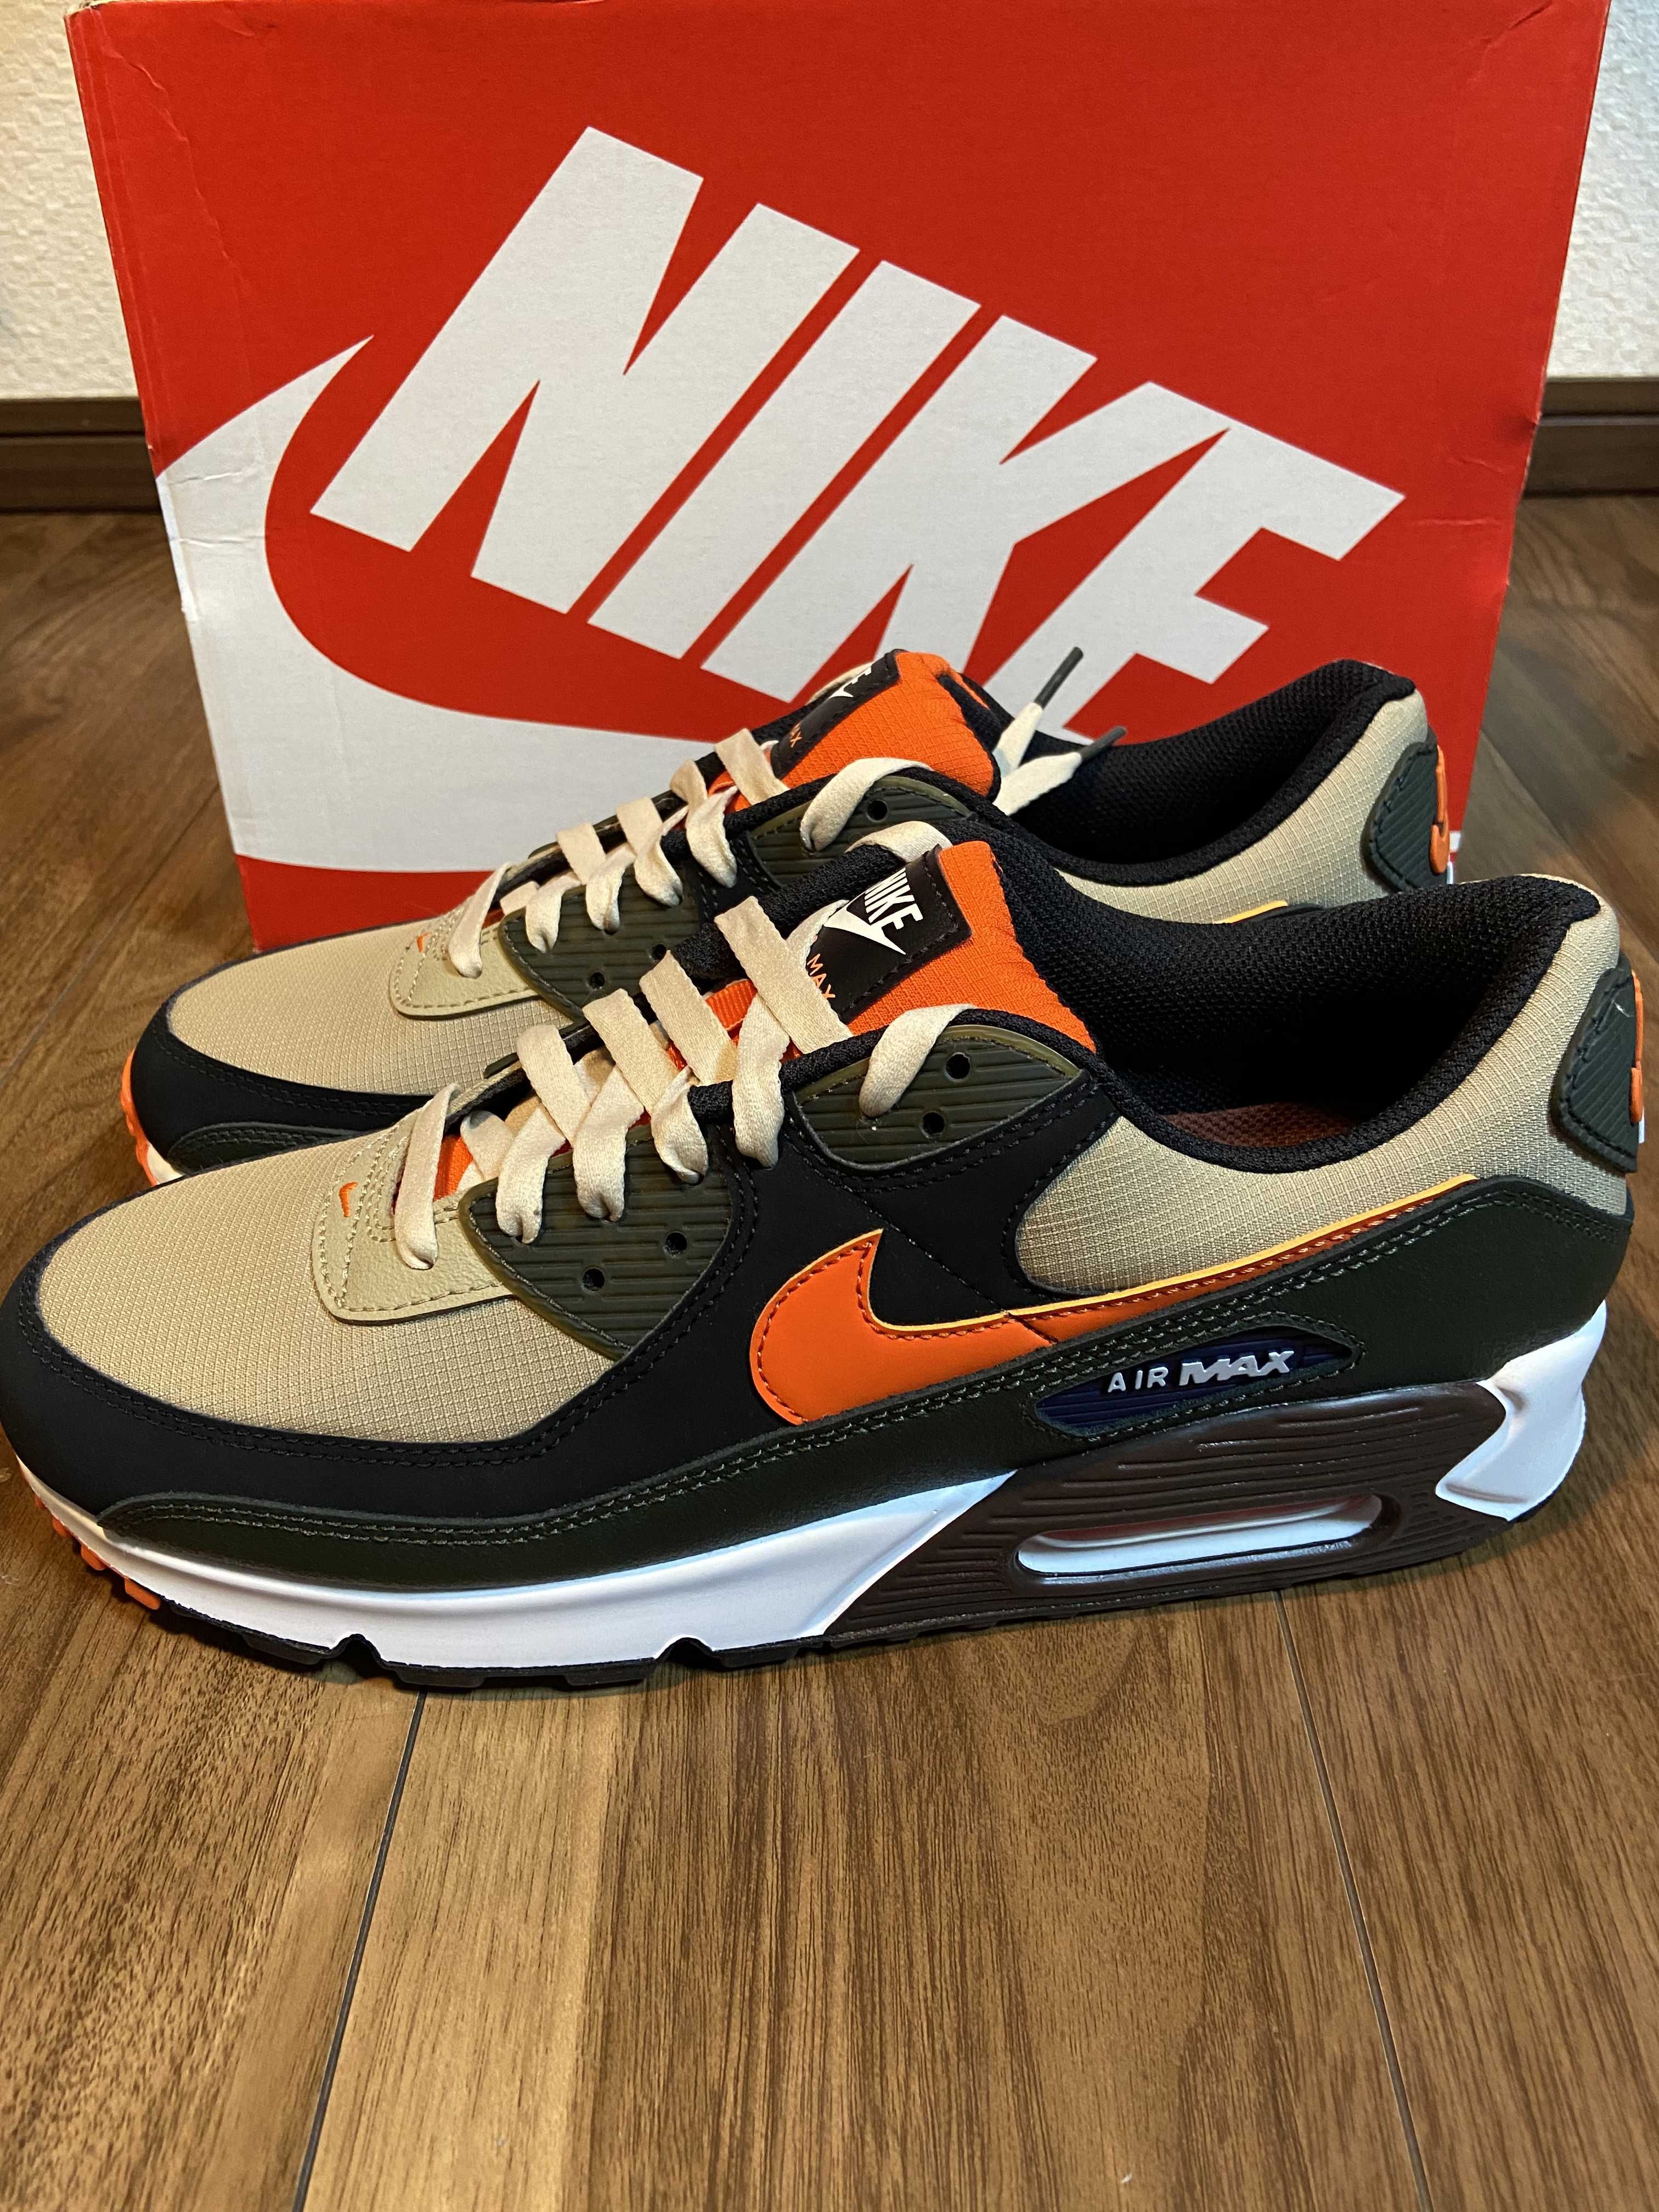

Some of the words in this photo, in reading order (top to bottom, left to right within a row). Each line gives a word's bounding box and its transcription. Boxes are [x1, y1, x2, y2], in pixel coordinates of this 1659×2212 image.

[310, 127, 1405, 746] NIKE
[864, 867, 923, 929] NIKE
[1107, 1366, 1169, 1392] AIR
[1178, 1350, 1294, 1386] MAX
